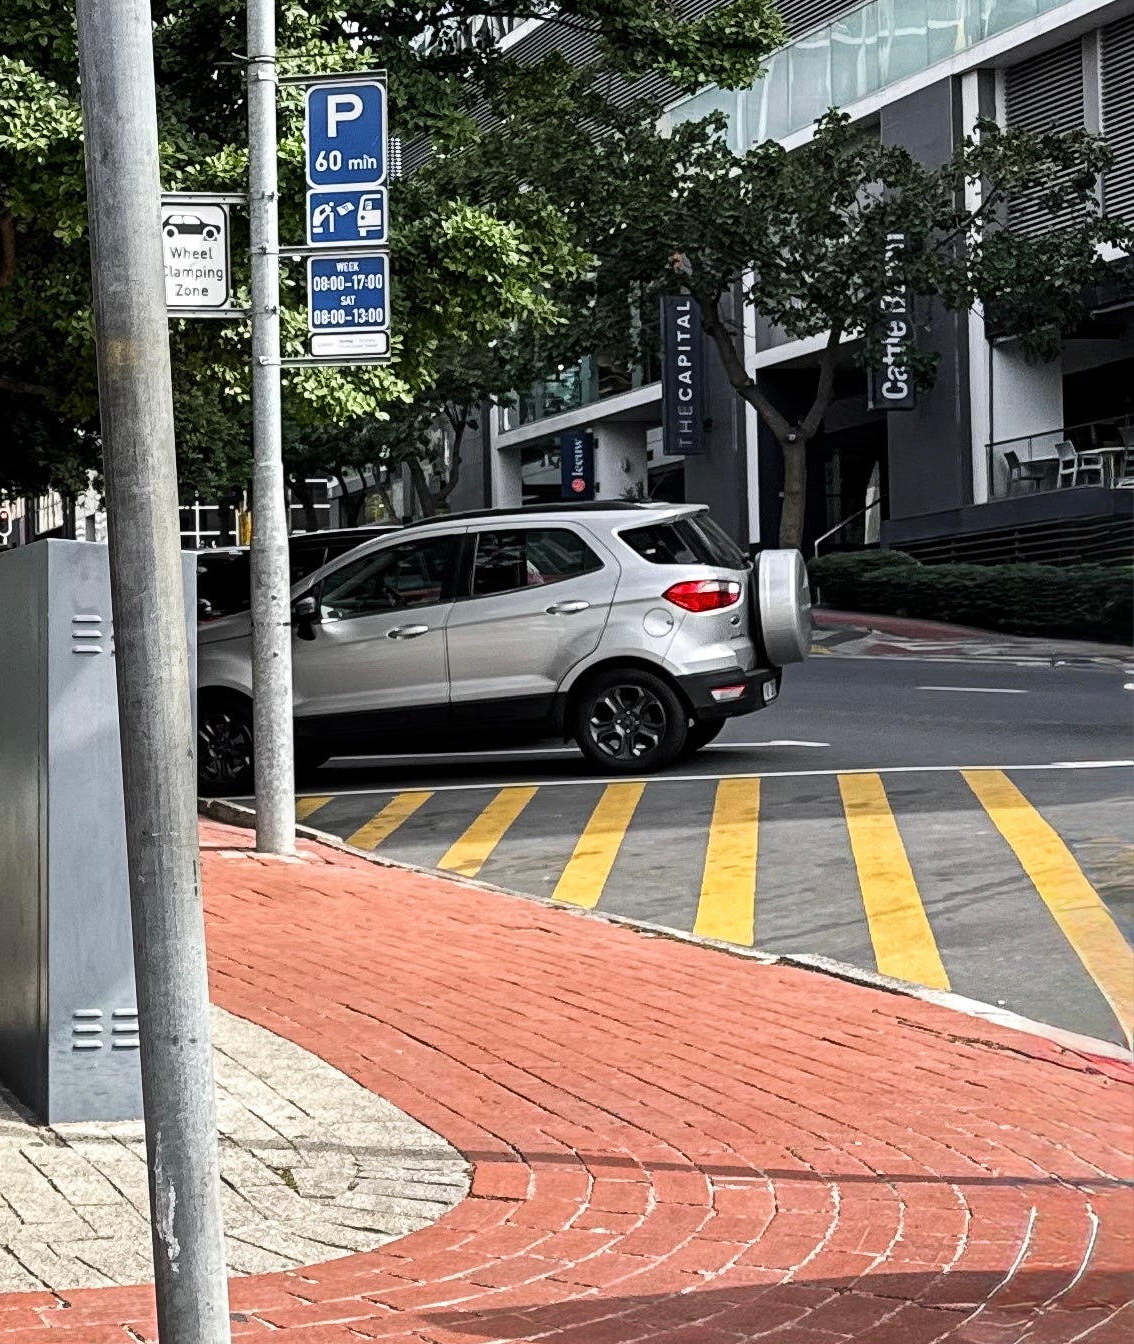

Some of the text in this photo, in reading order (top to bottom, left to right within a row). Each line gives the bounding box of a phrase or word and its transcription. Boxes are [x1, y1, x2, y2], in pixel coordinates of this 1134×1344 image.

[327, 93, 363, 138] P
[315, 150, 377, 172] 60 min
[169, 246, 213, 260] Wheel
[336, 261, 359, 273] WEEK
[175, 283, 209, 297] Zone
[340, 295, 356, 306] SAT
[676, 301, 693, 448] THE CAPITAL
